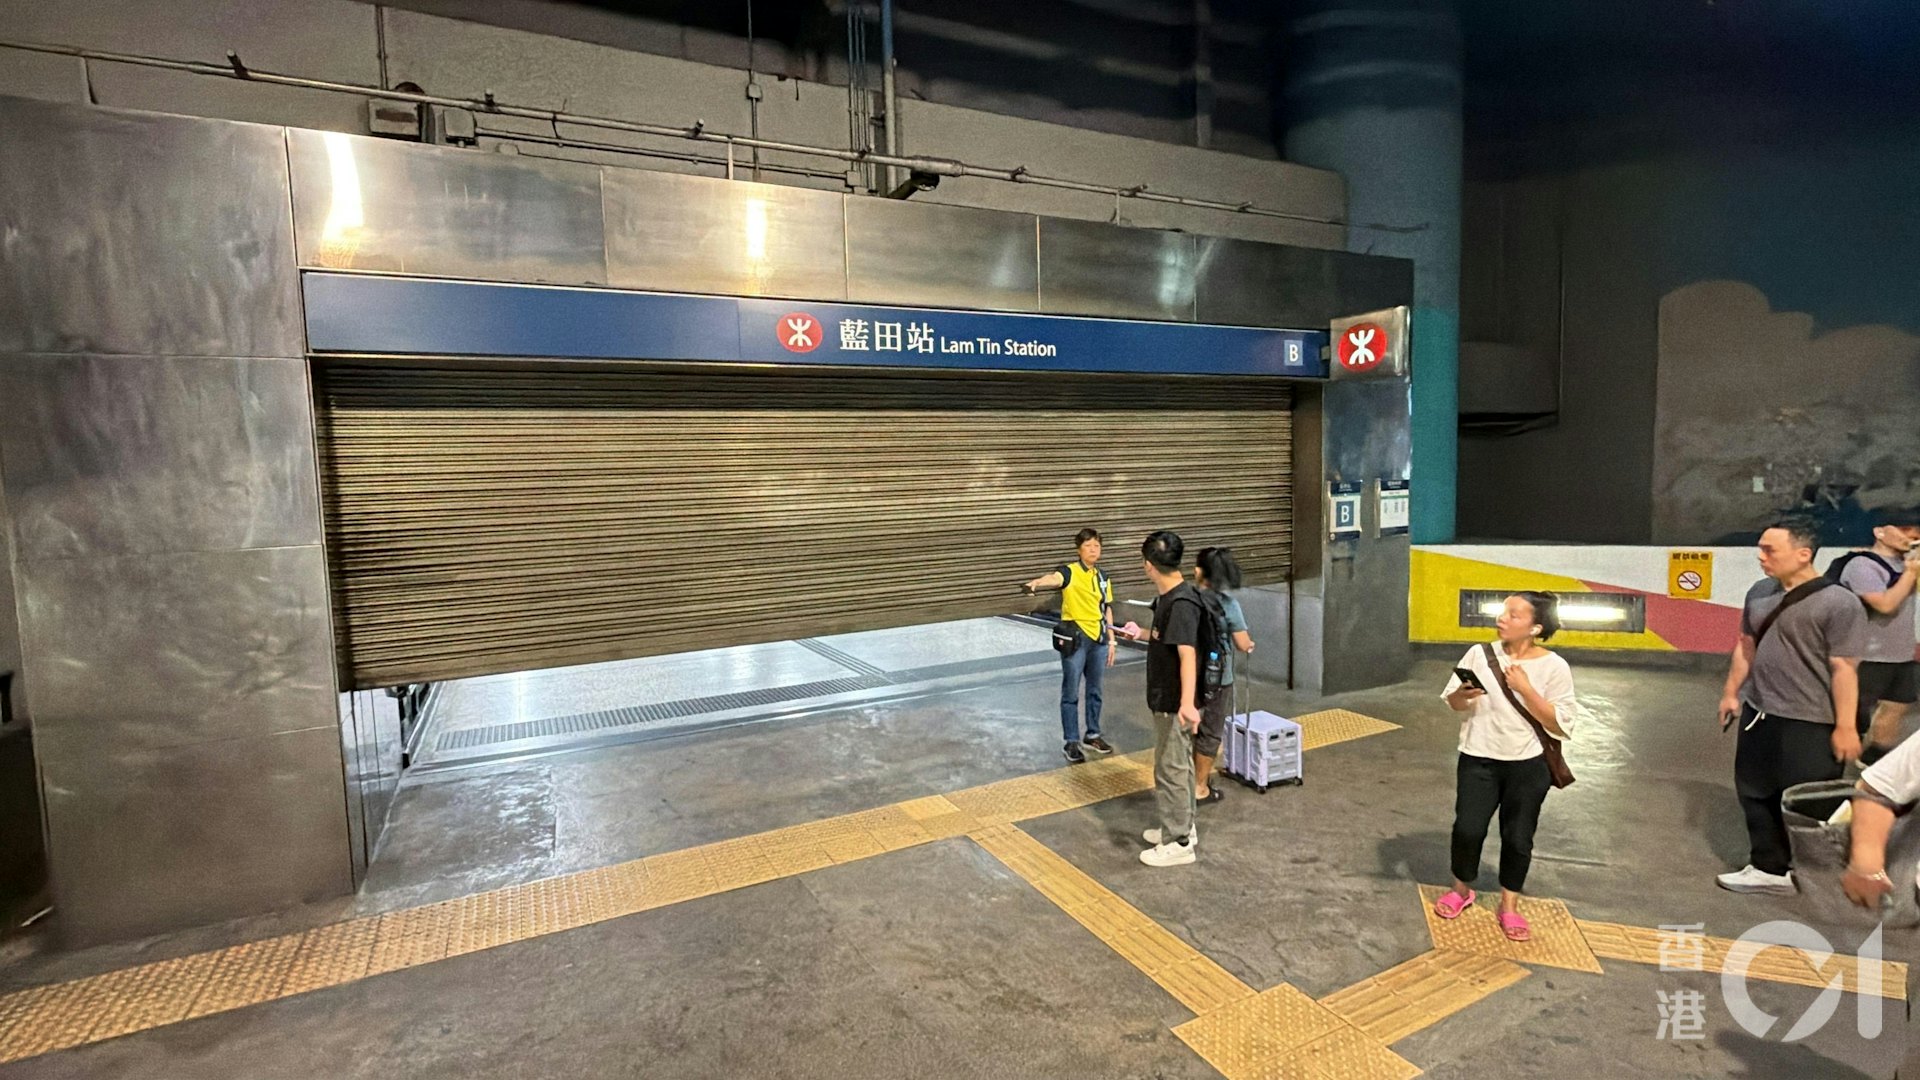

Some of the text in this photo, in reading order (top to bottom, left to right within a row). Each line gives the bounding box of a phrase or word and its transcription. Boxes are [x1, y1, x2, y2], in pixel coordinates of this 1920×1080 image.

[839, 319, 934, 354] 藍田站
[940, 337, 1057, 357] Lam Tin Station
[1289, 344, 1299, 362] B
[1341, 505, 1350, 523] B
